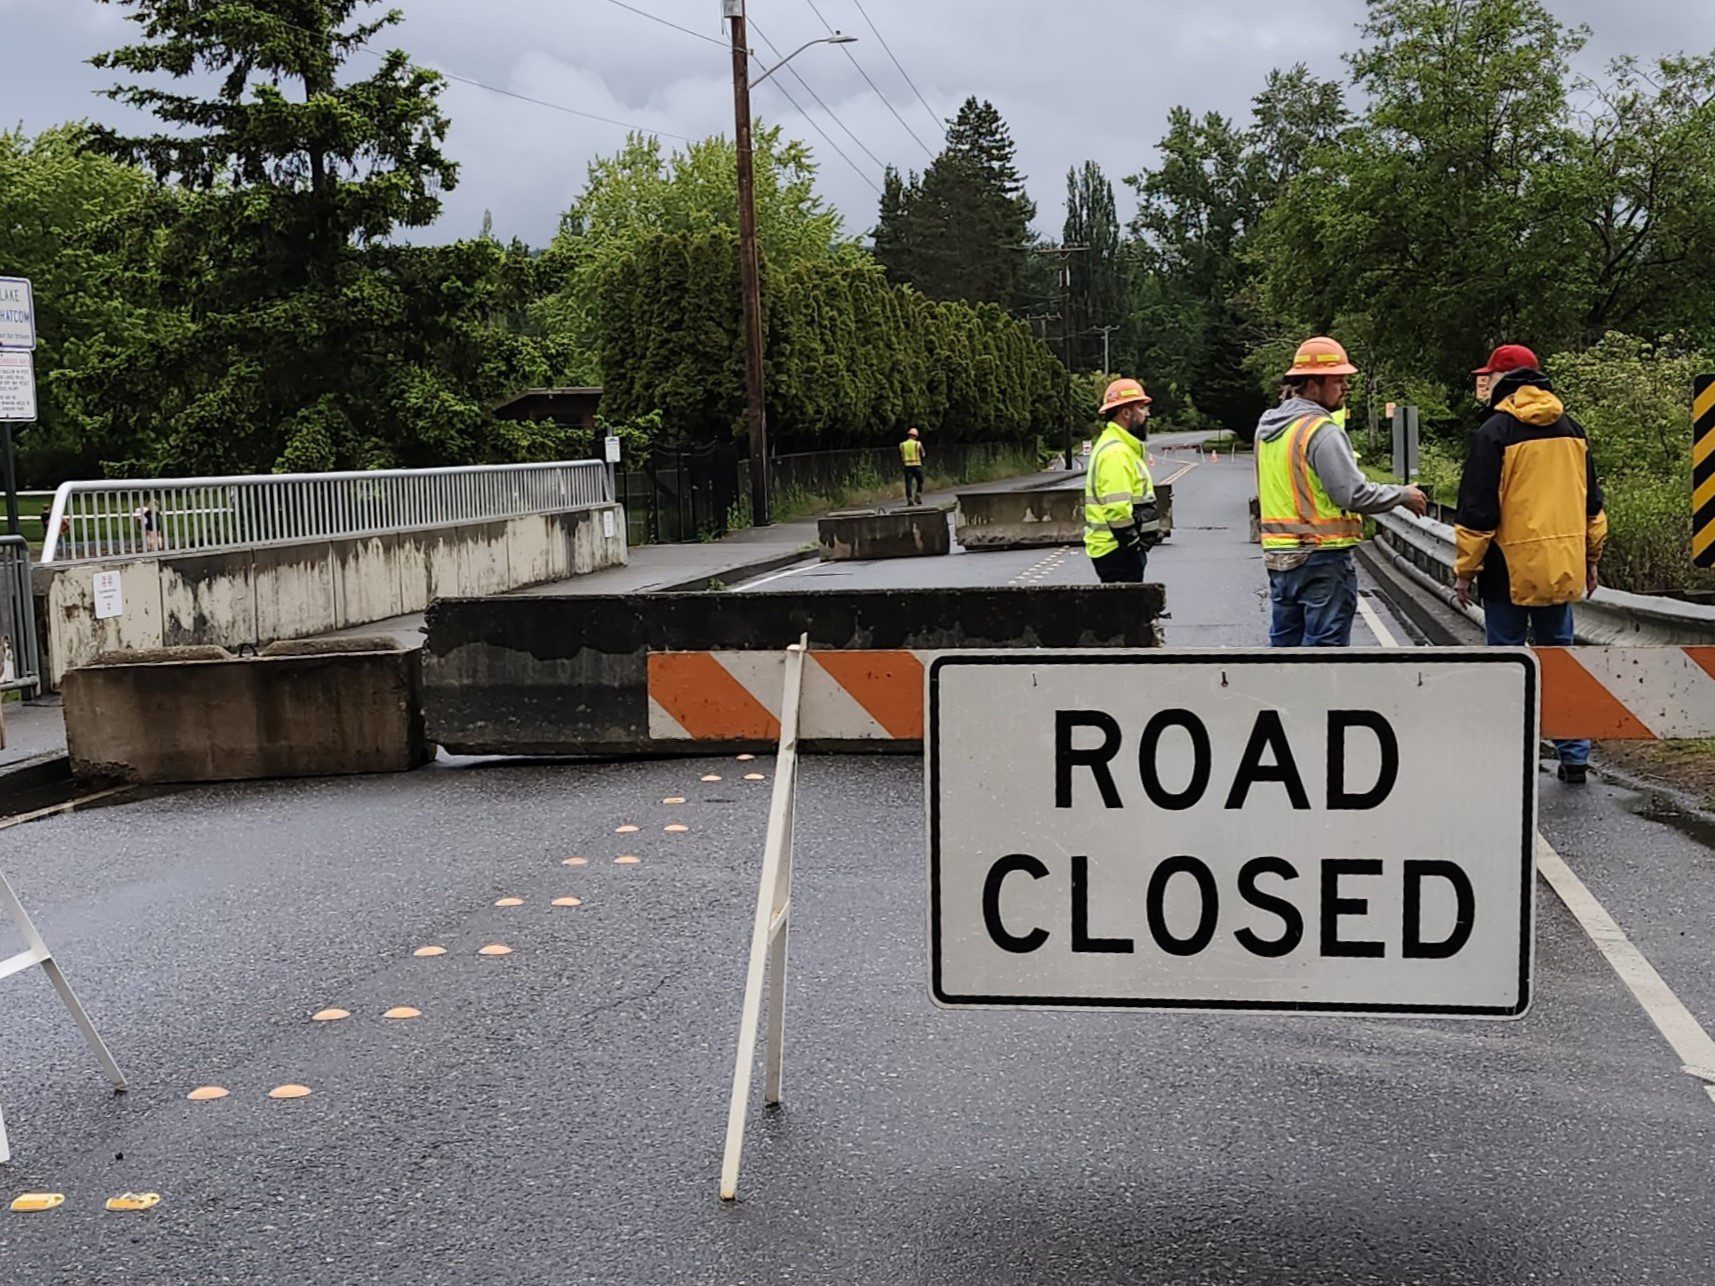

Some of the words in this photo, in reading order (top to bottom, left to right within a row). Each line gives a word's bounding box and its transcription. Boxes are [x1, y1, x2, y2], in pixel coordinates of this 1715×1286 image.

[0, 288, 19, 303] LAKE
[0, 309, 30, 324] HATCOM
[1055, 708, 1399, 811] ROAD
[982, 853, 1475, 959] CLOSED
